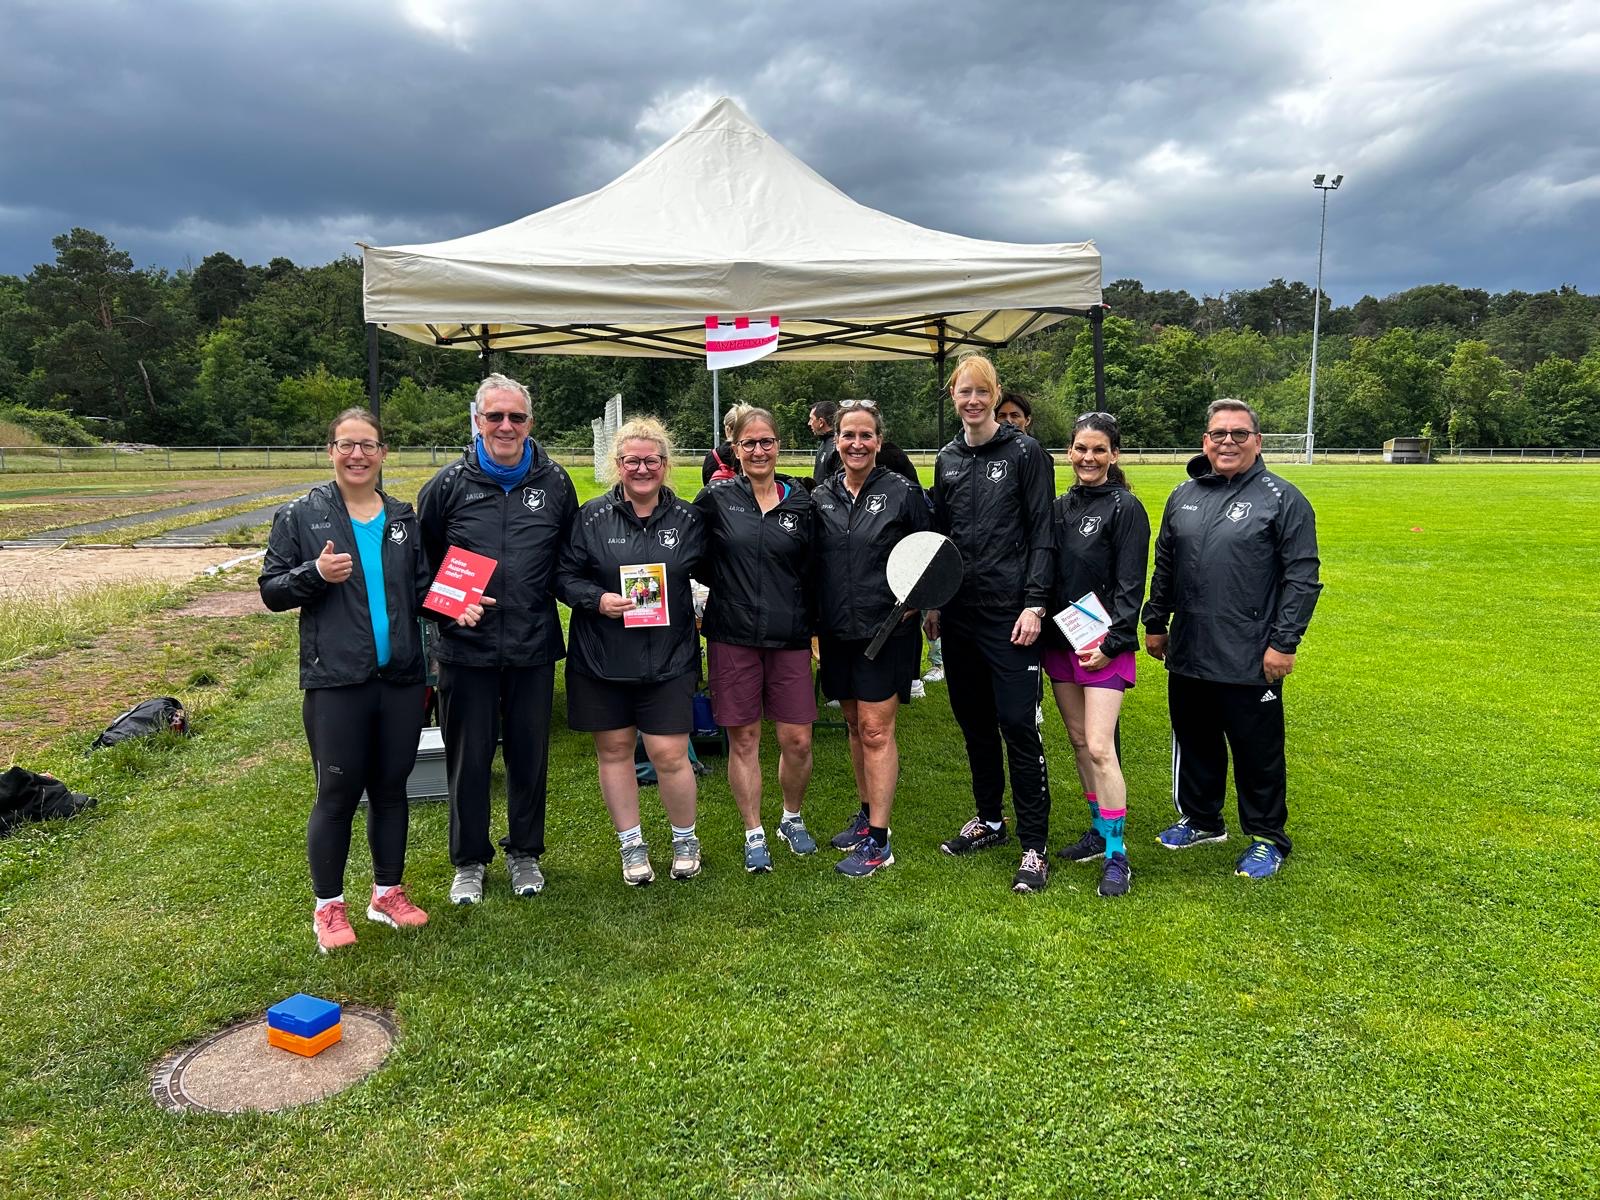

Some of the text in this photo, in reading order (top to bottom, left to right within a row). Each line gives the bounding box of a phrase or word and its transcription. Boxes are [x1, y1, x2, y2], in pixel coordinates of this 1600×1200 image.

[465, 492, 484, 501] JAKO
[310, 522, 331, 530] JAKO
[450, 557, 467, 567] Keine
[444, 570, 463, 580] mehr!
[447, 563, 475, 577] Ausreden
